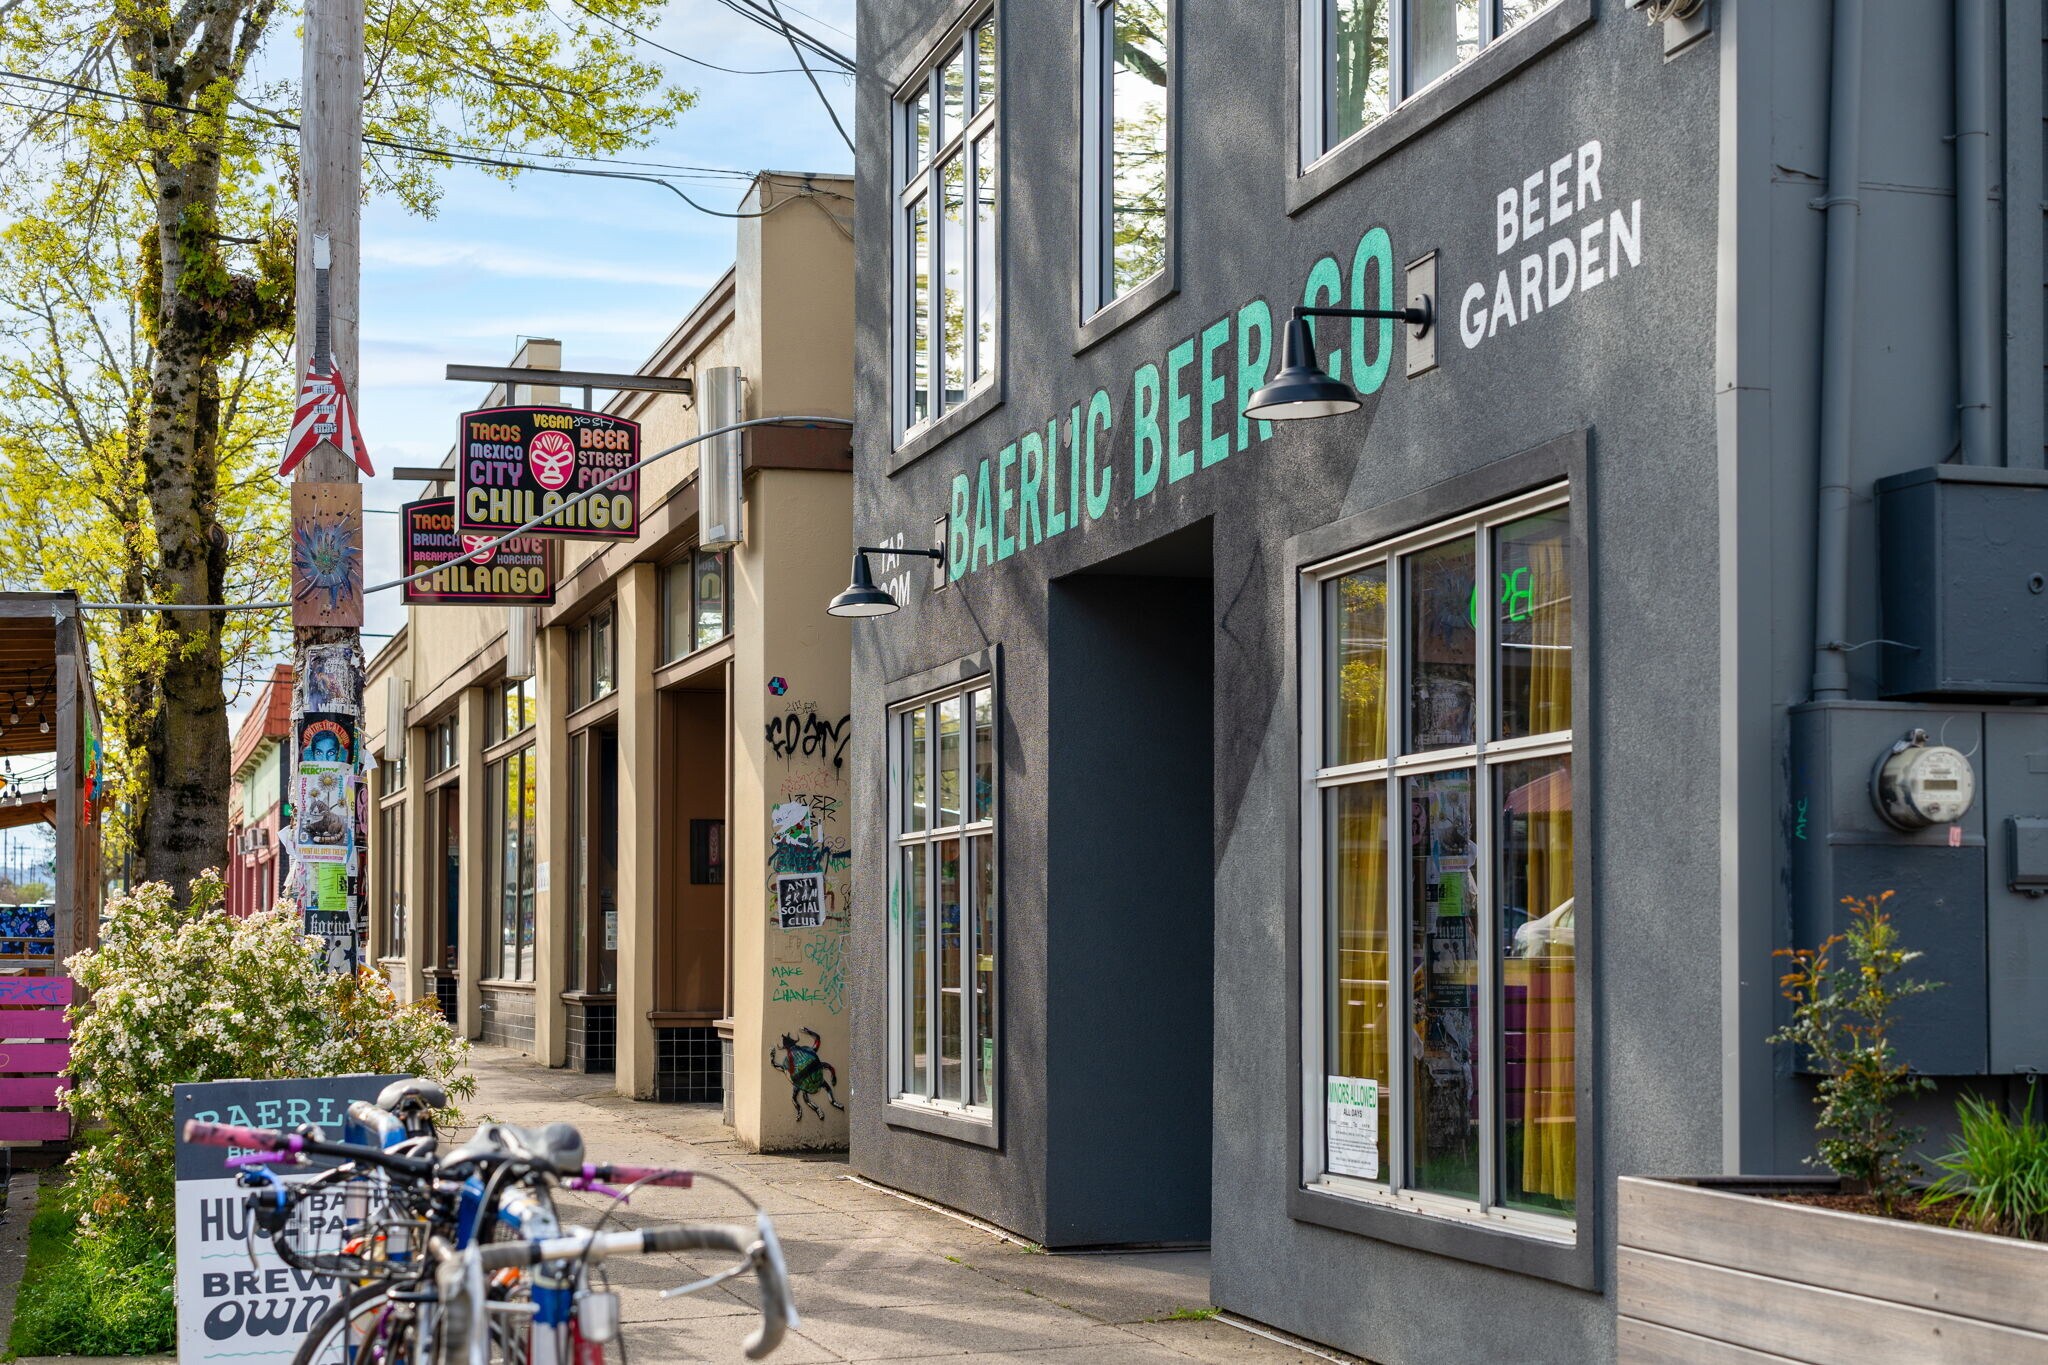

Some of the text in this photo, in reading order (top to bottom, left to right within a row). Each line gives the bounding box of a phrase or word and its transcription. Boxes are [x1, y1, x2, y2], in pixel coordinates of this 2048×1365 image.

[1496, 140, 1602, 255] BEER
[1460, 198, 1641, 349] GARDEN
[948, 227, 1394, 583] BAERLIC BEER CO
[533, 413, 573, 429] VEGAN
[470, 422, 522, 442] TACOS
[580, 427, 630, 451] BEER
[470, 443, 523, 460] MEXICO
[578, 450, 632, 468] STREET
[470, 460, 523, 487] CITY
[578, 466, 633, 492] FOOD
[466, 486, 633, 530] CHILANGO
[413, 533, 460, 547] BRUNCH
[501, 537, 543, 553] LOVE
[497, 554, 543, 565] HORCHATA
[880, 532, 904, 574] TAP
[414, 564, 545, 594] CHILANGO
[787, 878, 813, 893] ANTI
[781, 901, 820, 915] SOCIAL
[788, 917, 817, 926] CLUB
[771, 966, 804, 977] MAKE
[772, 987, 825, 1003] CHANGE
[1328, 1082, 1377, 1108] MINORS ALLOWED
